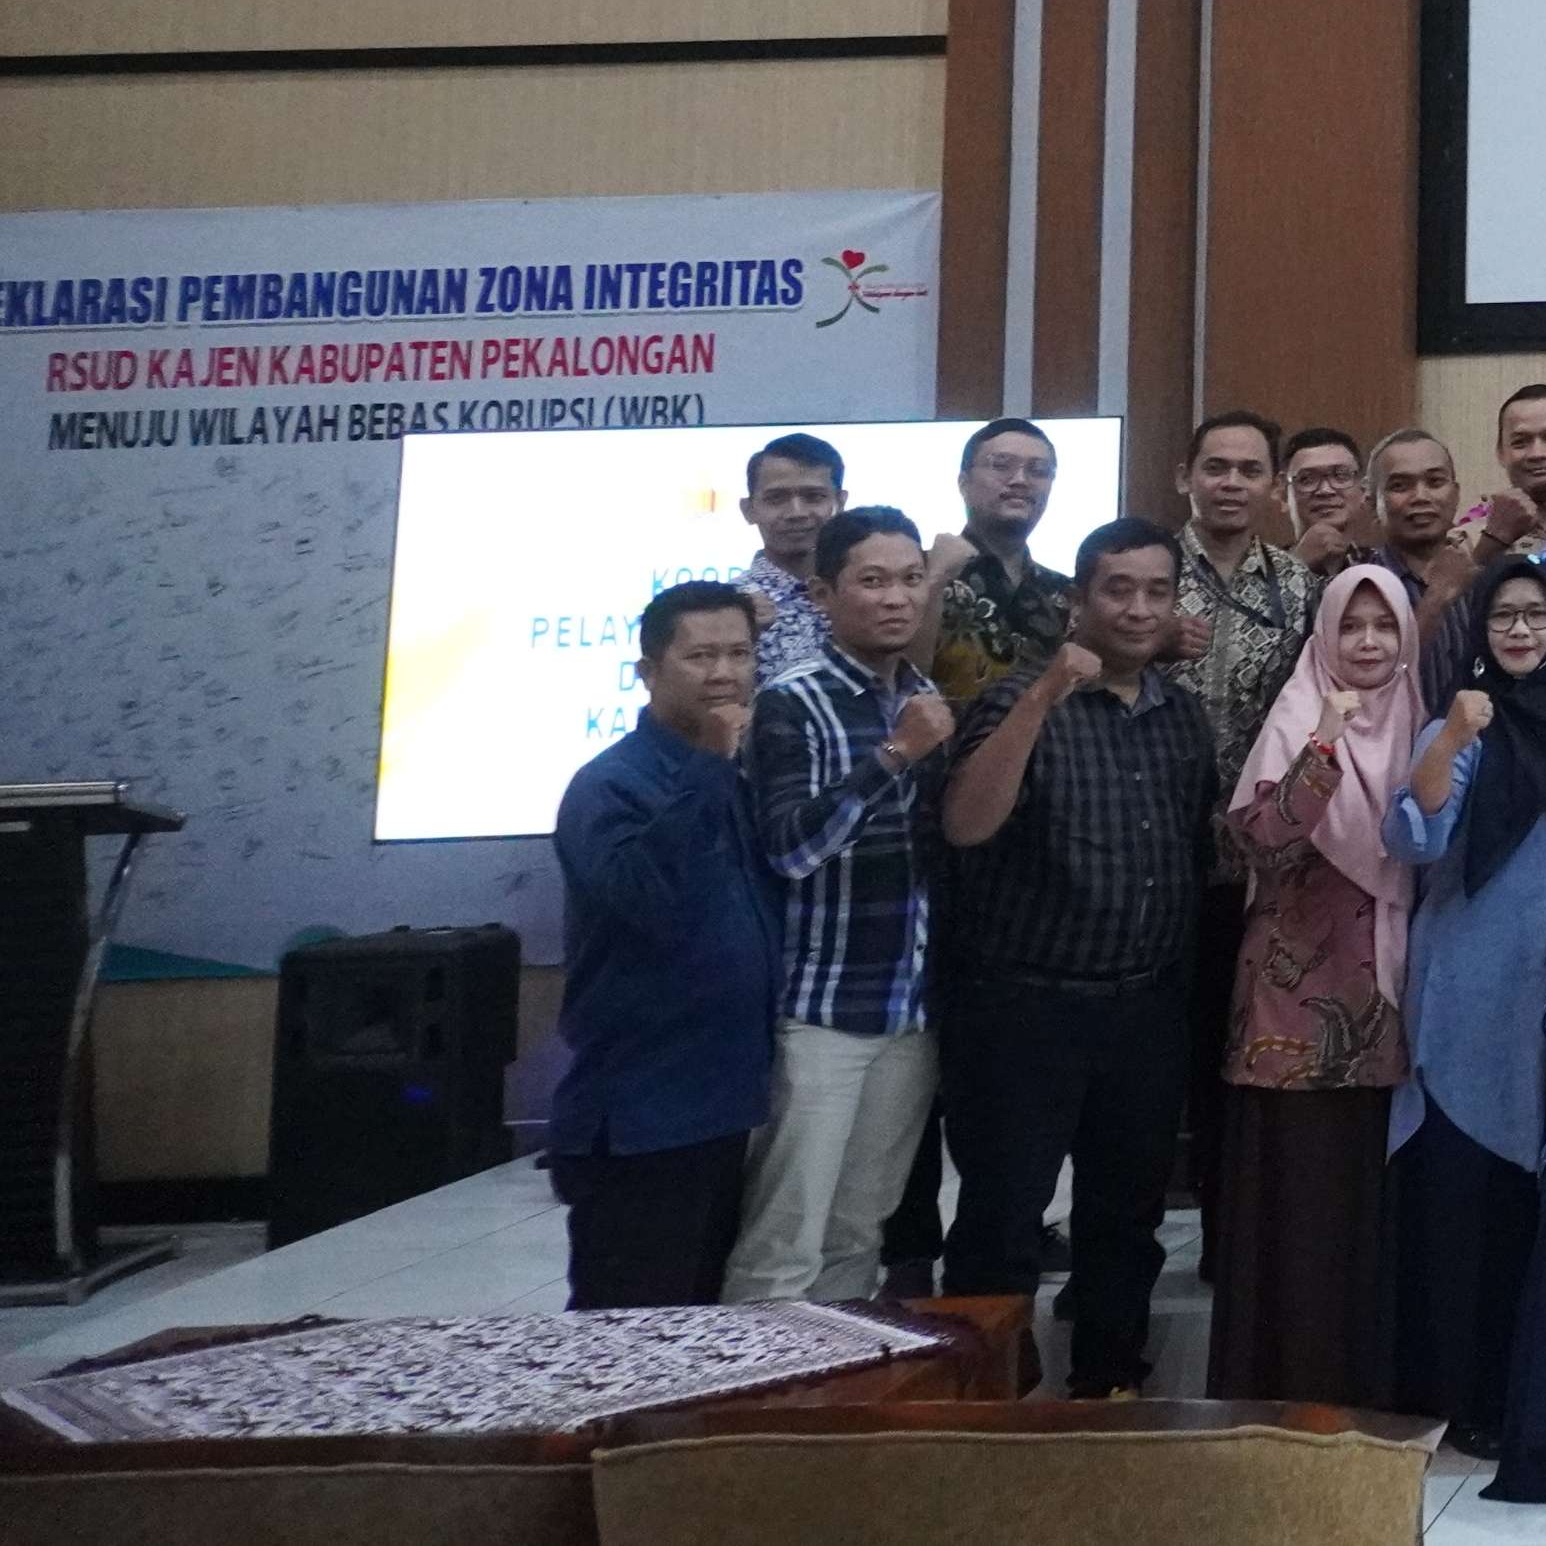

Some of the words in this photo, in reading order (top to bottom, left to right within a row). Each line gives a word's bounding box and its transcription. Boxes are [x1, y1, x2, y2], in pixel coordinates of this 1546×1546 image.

[177, 268, 468, 322] PEMBANGUNAN
[475, 264, 574, 314] ZONA
[584, 258, 805, 311] INTEGRITAS
[47, 349, 138, 392] RSUD
[146, 345, 261, 390] KAJEN
[267, 339, 474, 386] KABUPATEN
[480, 333, 717, 379] PEKALONGAN
[48, 409, 180, 450] MENUJU
[189, 404, 341, 446] WILAYAH
[347, 400, 449, 441] BEBAS
[459, 397, 595, 431] KORUPSI
